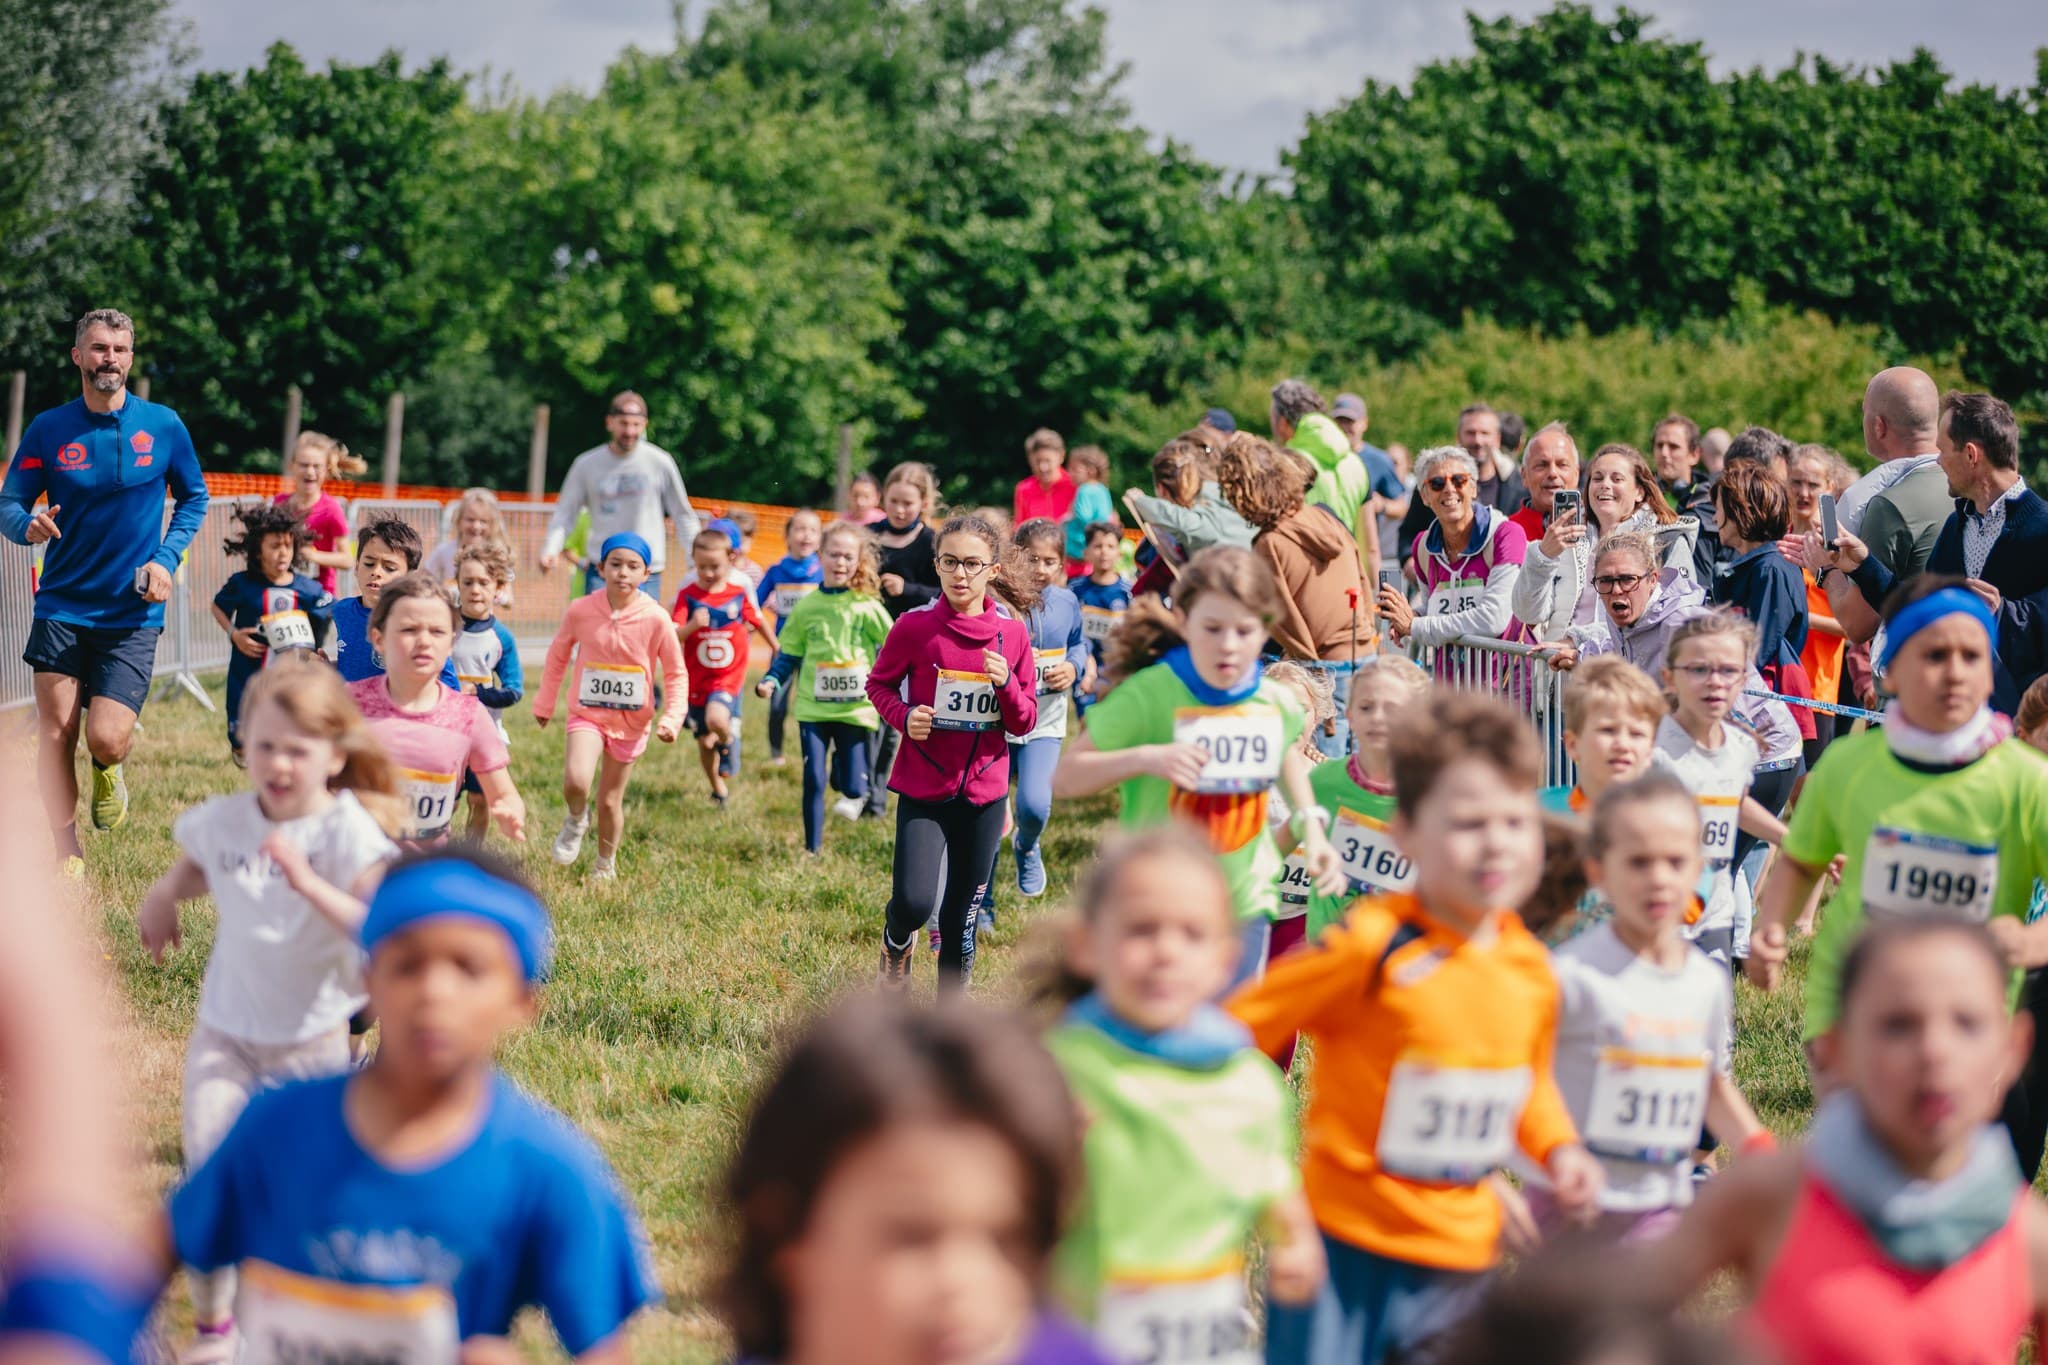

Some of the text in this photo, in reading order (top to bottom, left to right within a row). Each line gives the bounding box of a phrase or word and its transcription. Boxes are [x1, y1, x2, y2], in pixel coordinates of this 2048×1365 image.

[590, 678, 634, 697] 3043
[821, 675, 858, 691] 3055
[969, 722, 985, 730] CIC
[1341, 837, 1413, 881] 3160
[973, 882, 989, 901] WE
[1885, 861, 1977, 907] 1999
[965, 903, 981, 927] ARE
